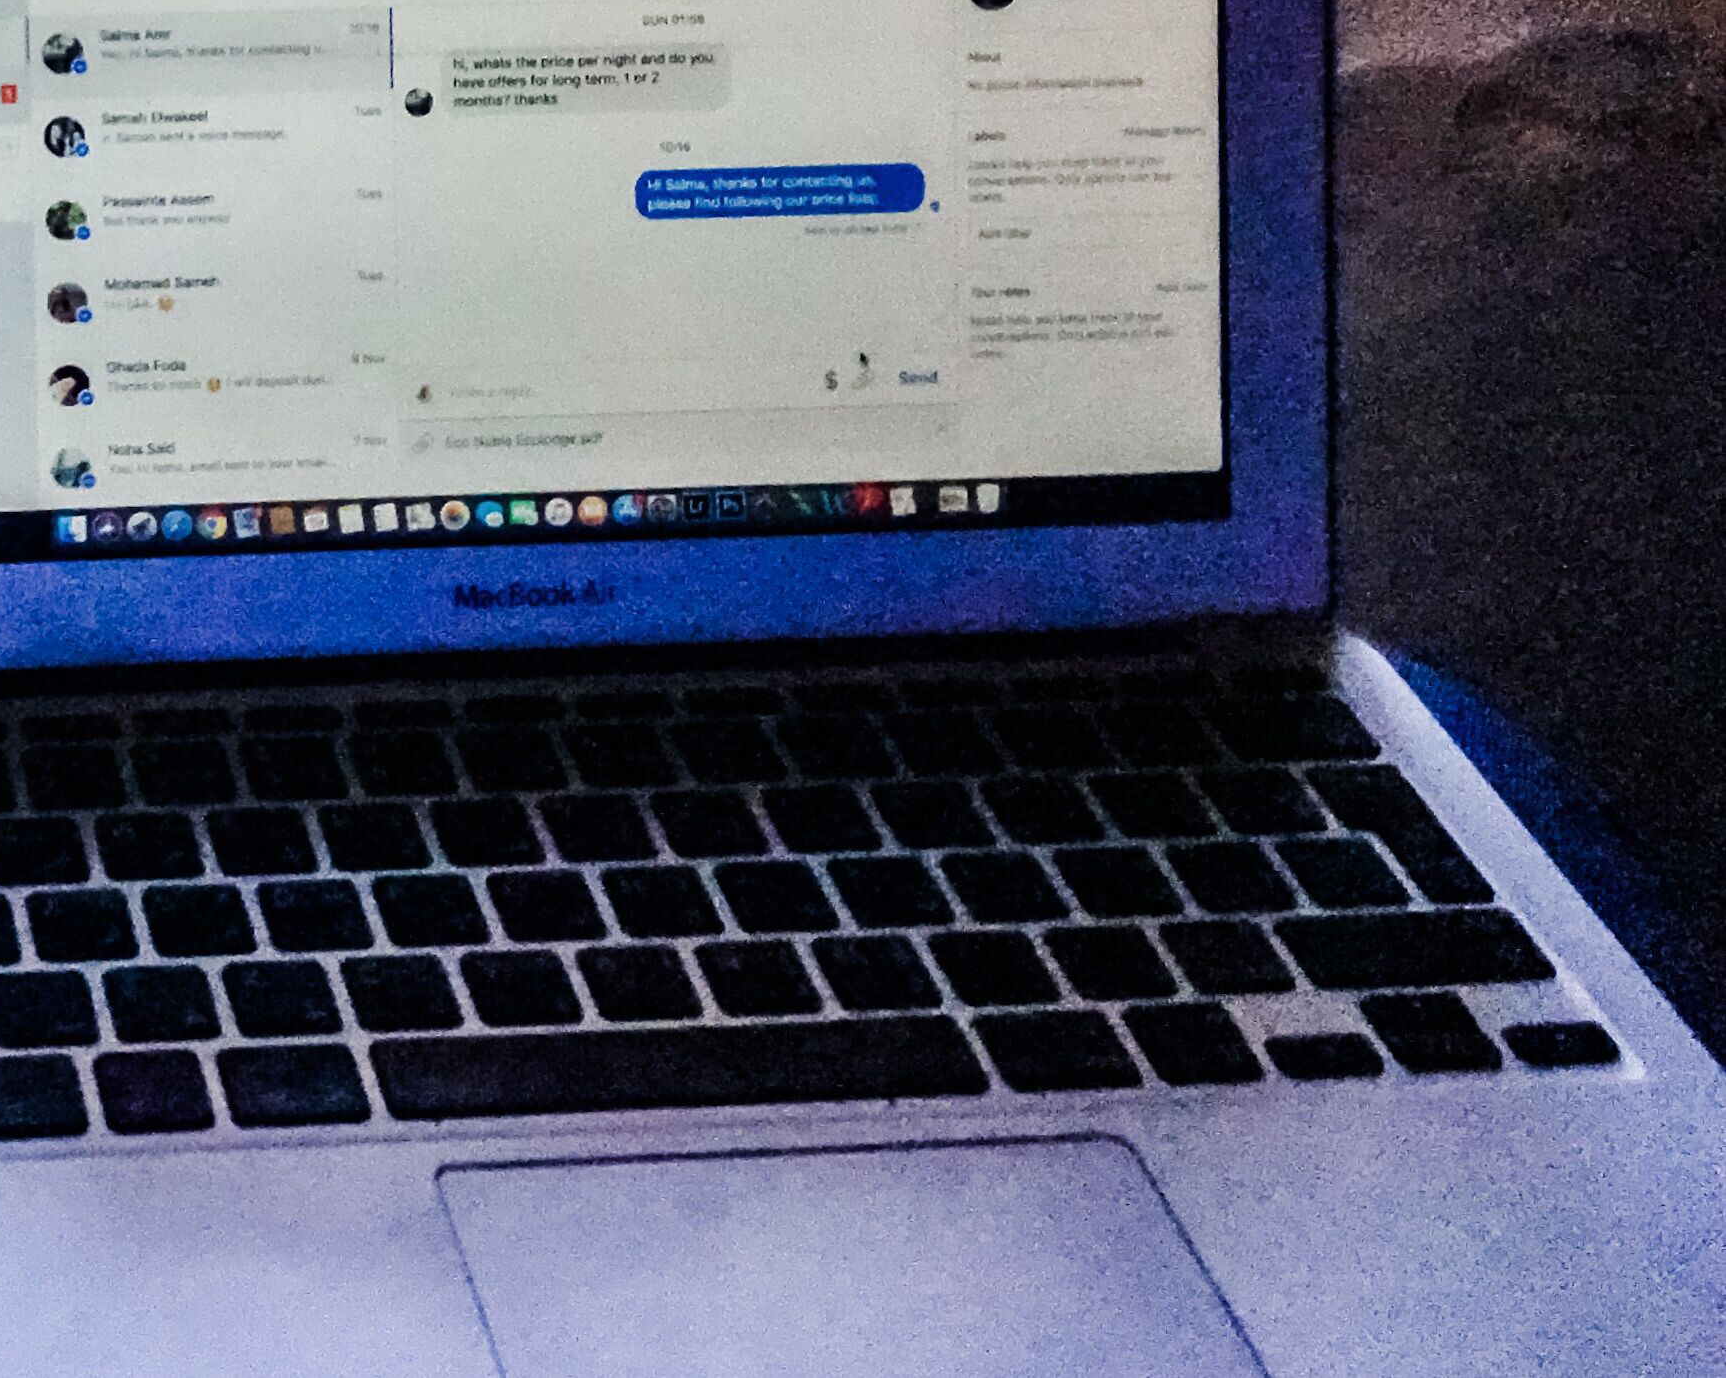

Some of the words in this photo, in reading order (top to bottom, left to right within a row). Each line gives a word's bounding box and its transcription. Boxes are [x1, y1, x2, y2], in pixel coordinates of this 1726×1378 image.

[452, 56, 469, 72] hi,
[473, 56, 512, 69] whats
[516, 55, 537, 68] the
[541, 55, 575, 72] price
[578, 56, 599, 70] per
[603, 53, 637, 69] night
[640, 52, 666, 65] and
[669, 52, 687, 64] do
[690, 53, 715, 68] you
[452, 75, 486, 88] have
[488, 75, 527, 88] offers
[530, 74, 549, 86] for
[552, 72, 582, 89] long
[633, 72, 648, 83] or
[651, 71, 661, 83] 2
[452, 93, 511, 107] months?
[514, 92, 559, 106] thanks
[647, 178, 662, 190] Hi
[665, 177, 710, 193] Salma,
[713, 175, 758, 190] thanks
[761, 175, 778, 189] for
[782, 174, 854, 190] contacting
[647, 197, 692, 213] please
[695, 195, 721, 209] find
[724, 194, 783, 210] following
[898, 370, 939, 385] Send
[453, 578, 576, 609] MacBook
[582, 577, 617, 606] Air
